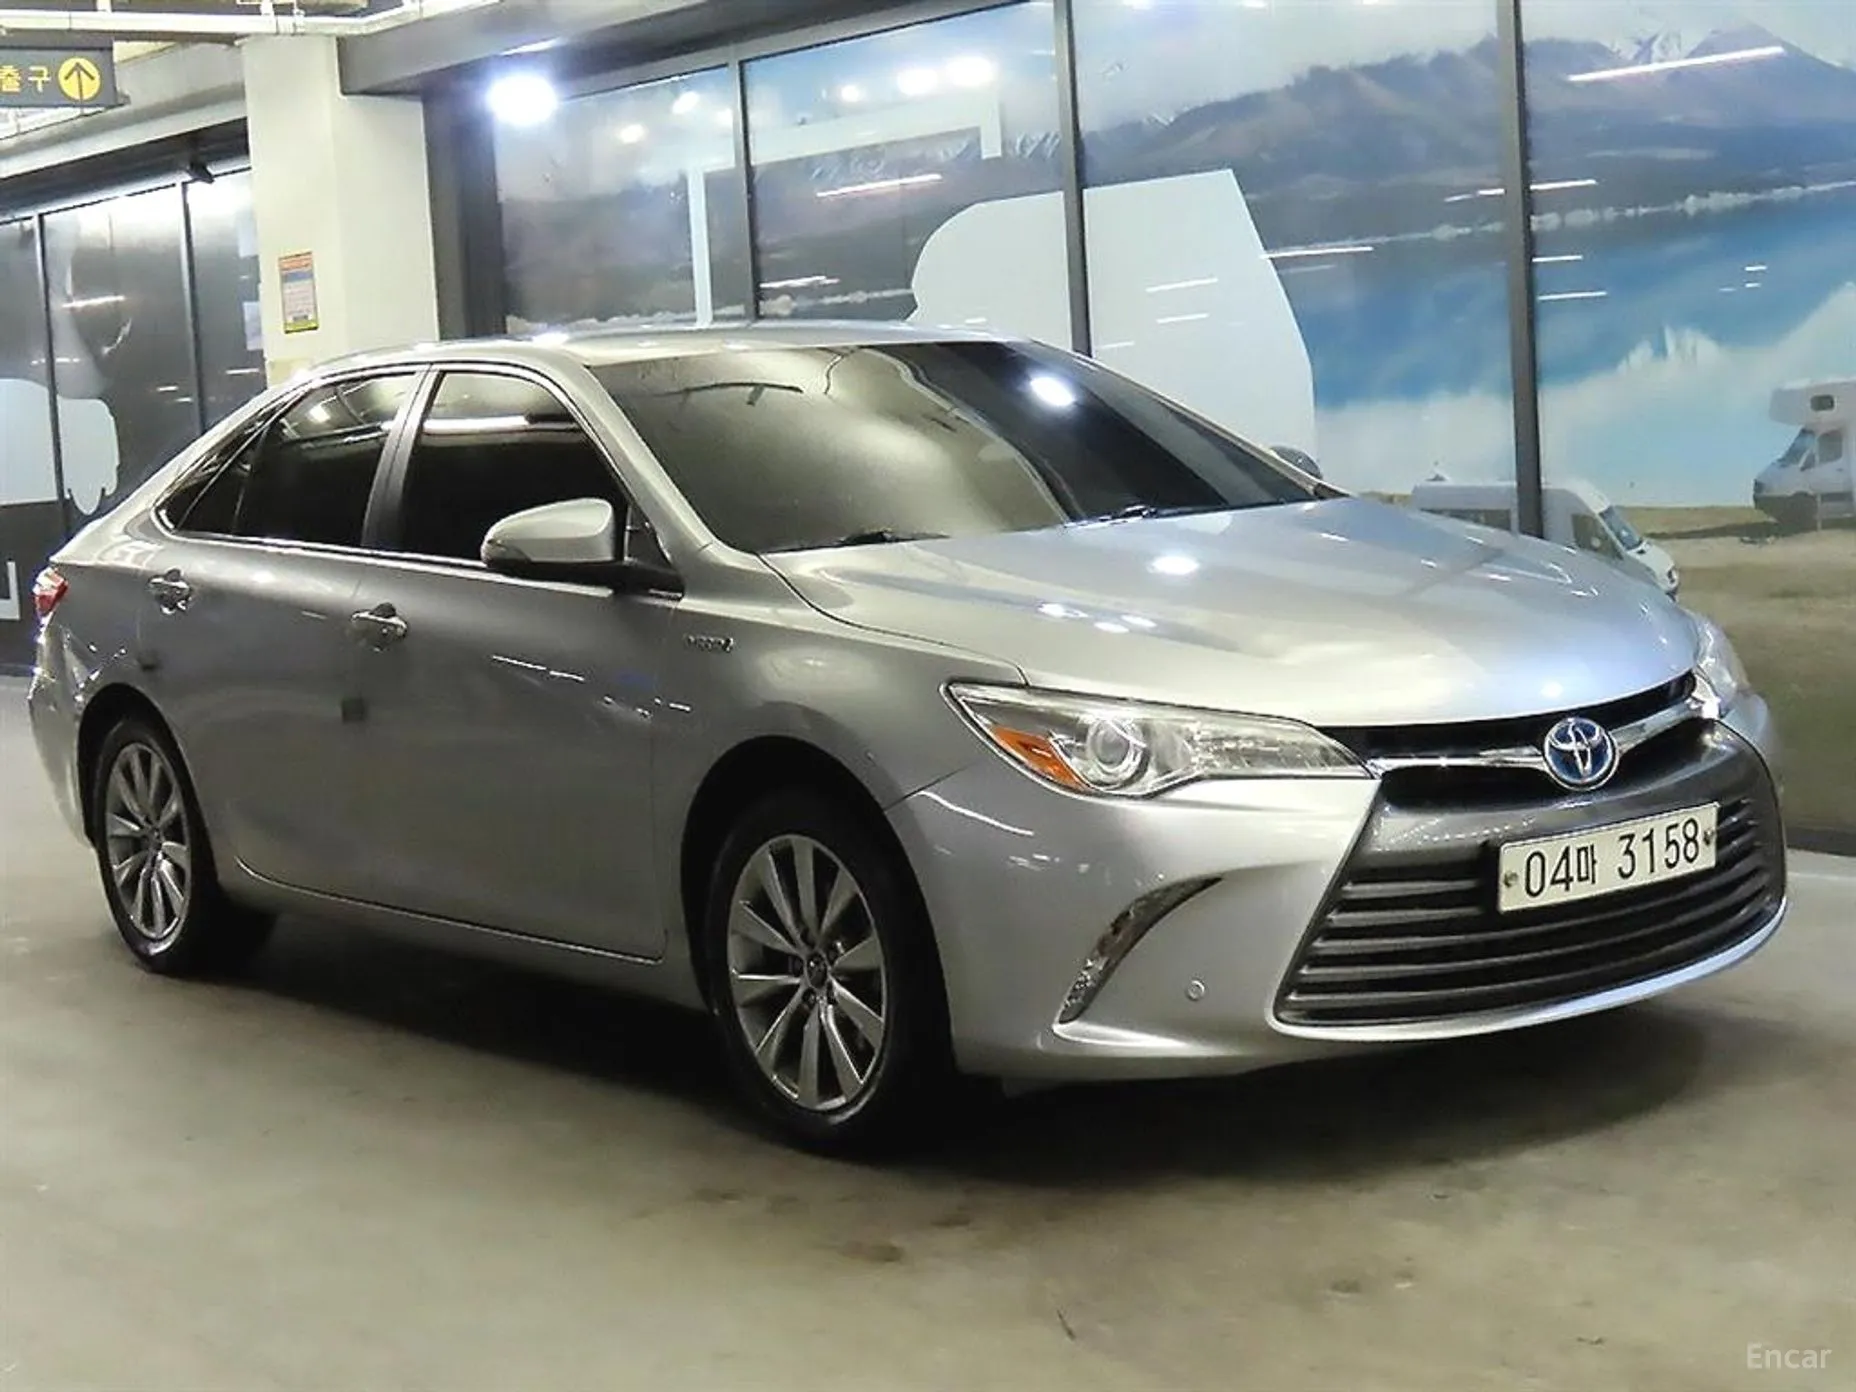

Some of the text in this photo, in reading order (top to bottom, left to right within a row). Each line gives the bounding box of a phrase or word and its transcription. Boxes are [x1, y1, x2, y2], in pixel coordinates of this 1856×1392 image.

[0, 65, 51, 93] 출구
[1524, 818, 1699, 898] 04마 3158
